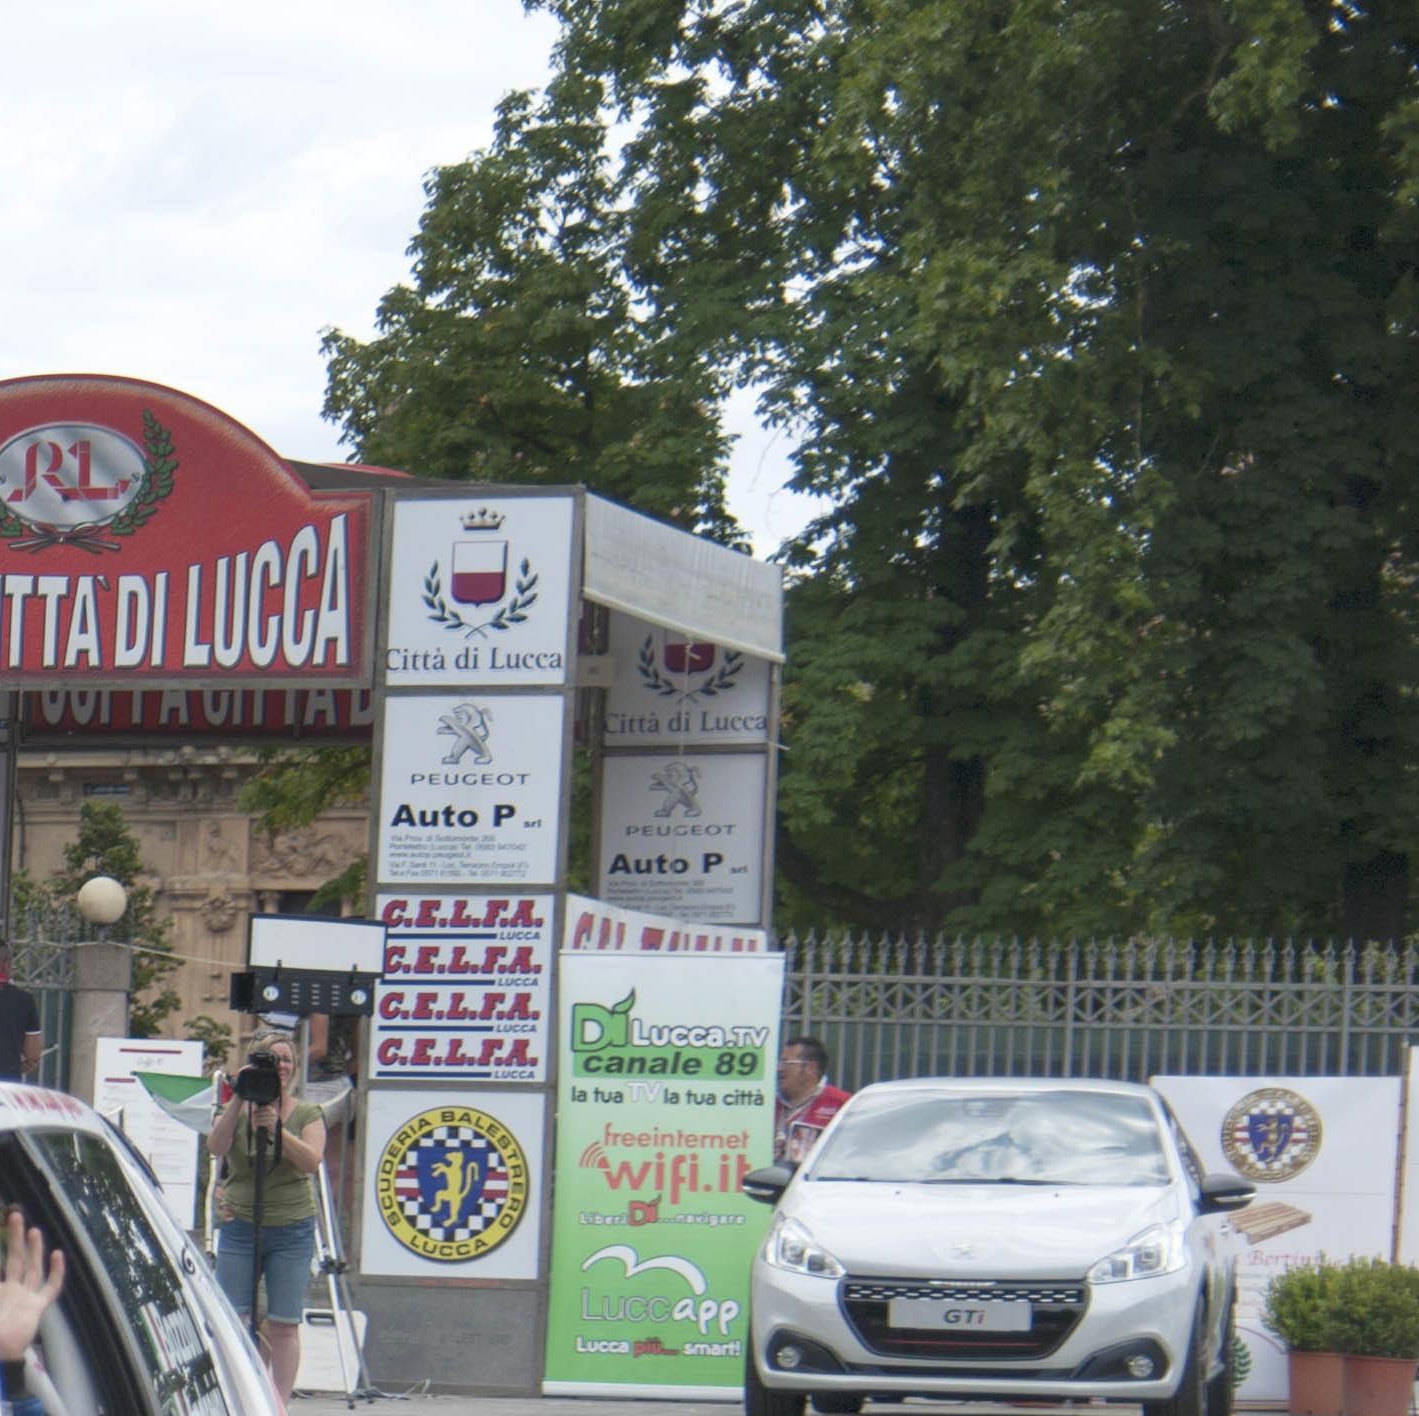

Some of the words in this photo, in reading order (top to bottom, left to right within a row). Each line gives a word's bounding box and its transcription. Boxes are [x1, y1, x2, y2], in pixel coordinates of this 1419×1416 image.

[113, 570, 168, 670] DI
[182, 512, 352, 671] LUCCA
[385, 644, 444, 673] Città
[455, 644, 482, 672] di
[489, 646, 563, 672] Lucca
[604, 710, 659, 735] Città
[668, 710, 690, 734] di
[699, 710, 768, 733] Lucca
[410, 773, 531, 787] PEUGEOT
[389, 804, 479, 828] Auto
[492, 804, 516, 827] P
[522, 817, 542, 829] srl
[624, 824, 737, 838] PEUGEOT
[607, 852, 689, 875] Auto
[701, 852, 724, 875] P
[382, 899, 544, 928] C.E.L.F.A.
[498, 930, 541, 941] LUCCA
[384, 945, 543, 975] C.E.L.F.A.
[496, 978, 540, 988] LUCCA
[379, 991, 541, 1021] C.E.L.F.A.
[494, 1023, 538, 1034] LUCCA
[376, 1037, 540, 1067] C.E.L.F.A.
[582, 1050, 703, 1075] canale
[714, 1051, 758, 1076] 89
[493, 1070, 536, 1080] LUCCA
[570, 1085, 587, 1103] la
[593, 1086, 625, 1104] tua
[626, 1082, 662, 1100] TV
[663, 1088, 680, 1105] la
[684, 1089, 717, 1106] tua
[722, 1089, 765, 1107] città
[604, 1122, 750, 1150] freeinternet
[379, 1117, 432, 1227] SCUDERIA
[440, 1110, 524, 1229] BALESTRERO
[600, 1152, 752, 1205] wifi.it
[409, 1234, 489, 1257] LUCCA
[942, 1308, 986, 1326] GTi
[576, 1336, 630, 1354] Lucca
[683, 1339, 741, 1357] smart!
